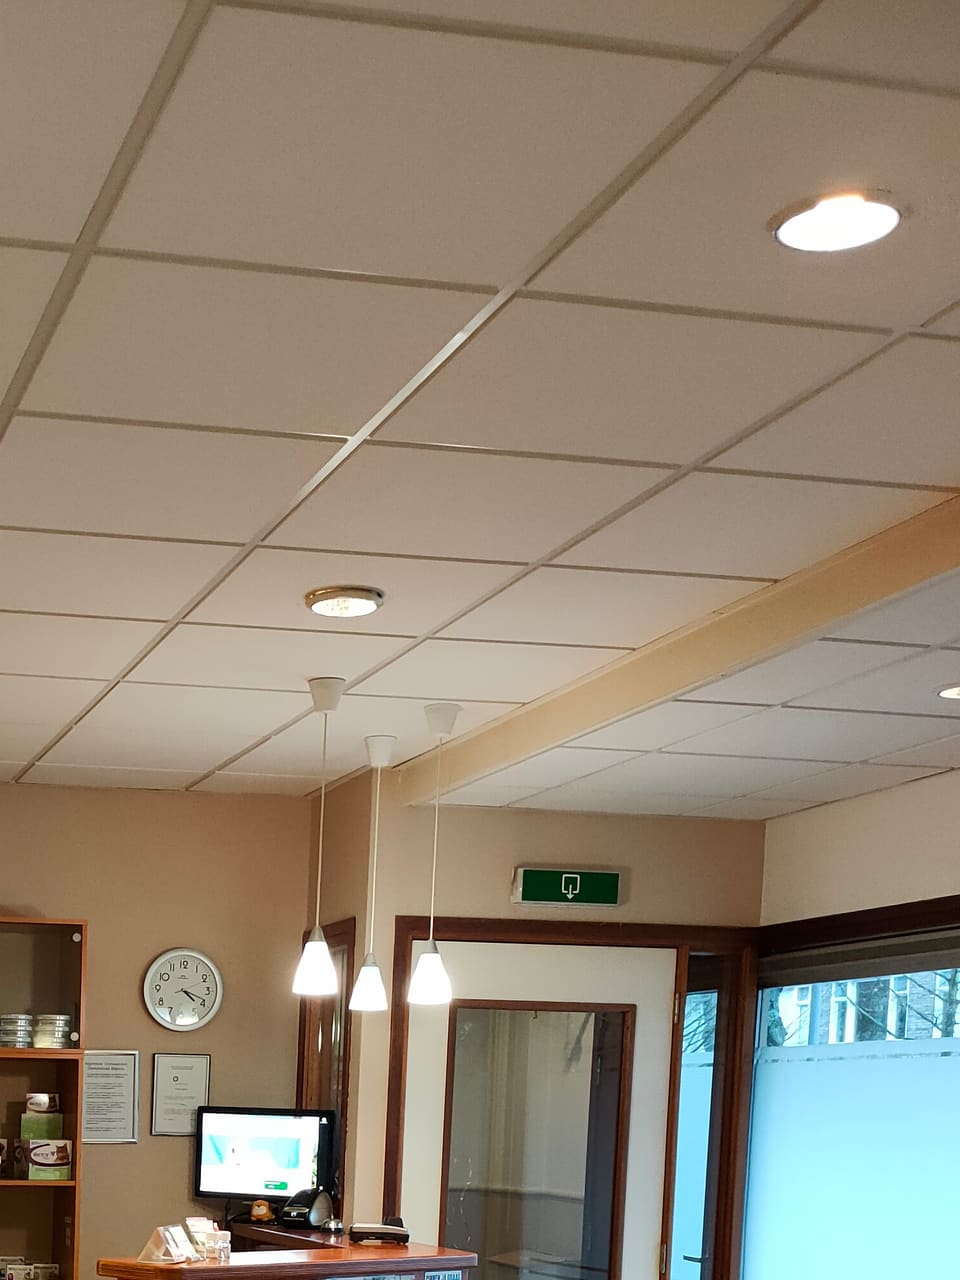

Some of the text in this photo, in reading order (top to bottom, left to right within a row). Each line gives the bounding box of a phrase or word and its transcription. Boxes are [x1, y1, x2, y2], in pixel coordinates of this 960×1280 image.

[169, 963, 175, 972] 11
[180, 960, 189, 969] 12
[159, 972, 170, 982] 10
[201, 973, 208, 983] 2
[154, 984, 162, 992] 9
[204, 986, 211, 996] 3
[158, 997, 164, 1006] 8
[199, 999, 206, 1008] 4
[168, 1006, 173, 1015] 7
[191, 1007, 197, 1016] 5
